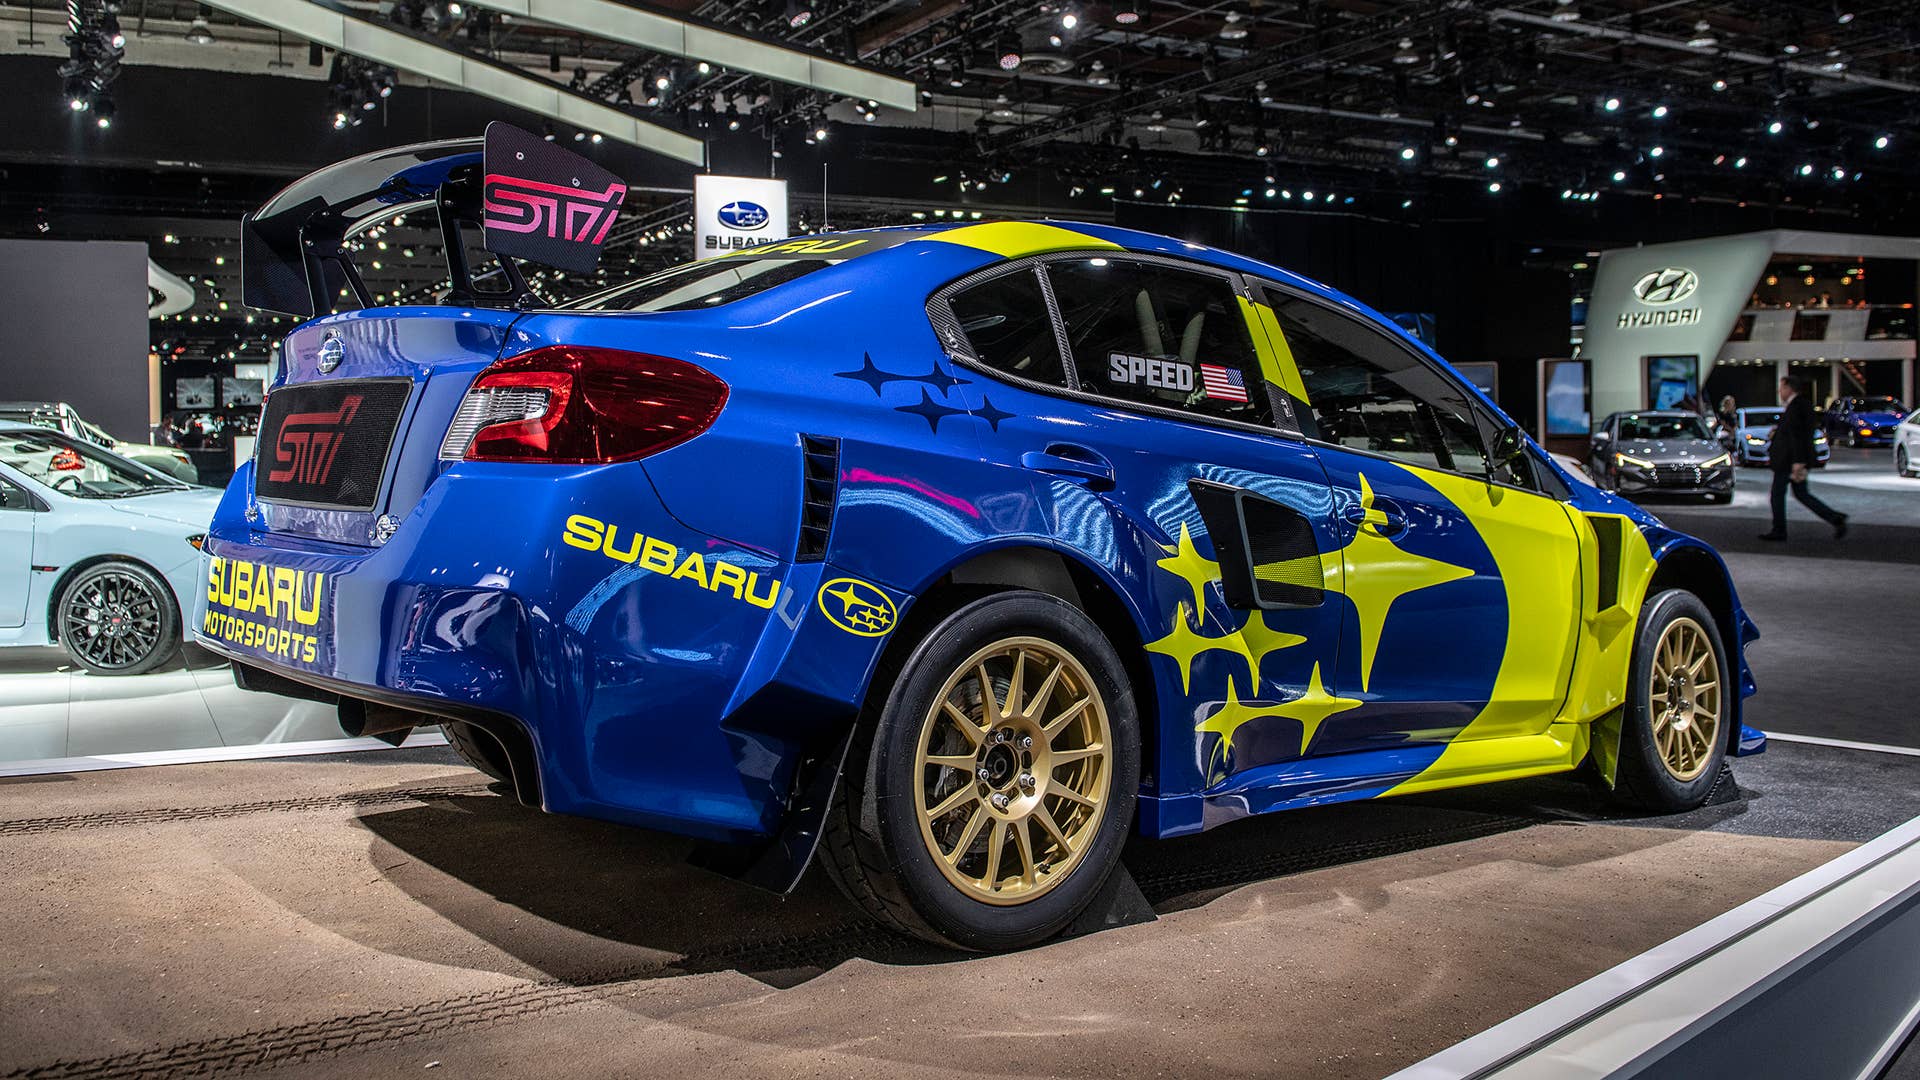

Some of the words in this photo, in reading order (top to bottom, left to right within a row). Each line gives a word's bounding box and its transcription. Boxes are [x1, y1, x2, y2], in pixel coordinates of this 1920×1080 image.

[705, 235, 781, 249] SUBA
[1617, 308, 1702, 329] HYUNDAI
[1110, 353, 1194, 392] SPEED
[563, 514, 782, 609] SUBARU
[207, 557, 324, 626] SUBARU
[203, 608, 318, 663] MOTORSPORTS
